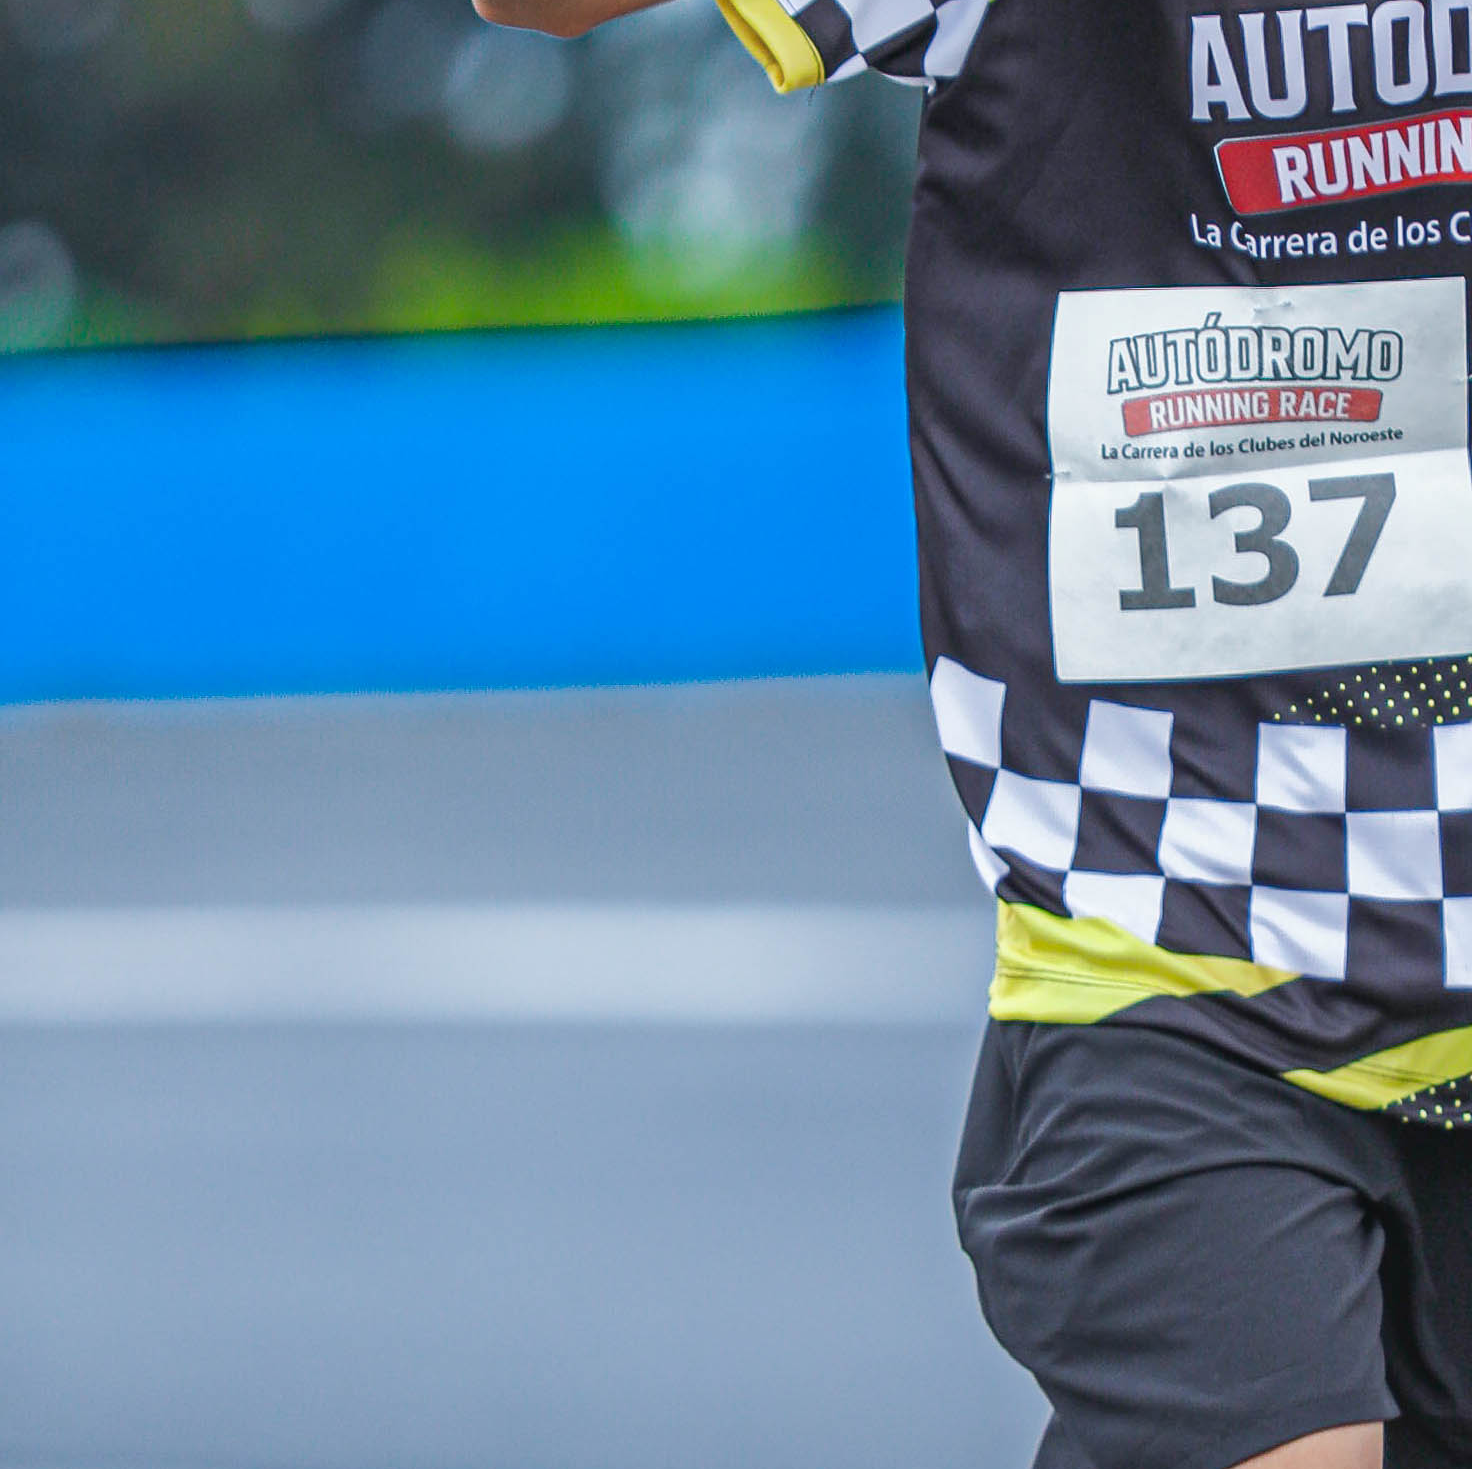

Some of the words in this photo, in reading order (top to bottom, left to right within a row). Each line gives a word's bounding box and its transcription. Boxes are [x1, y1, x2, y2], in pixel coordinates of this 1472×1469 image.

[1191, 212, 1222, 248] La
[1230, 220, 1338, 259] Carrera
[1348, 220, 1387, 254] de
[1396, 215, 1441, 248] los
[1106, 311, 1404, 395] AUTÓDROMO
[1149, 390, 1270, 430] RUNNING
[1279, 390, 1352, 420] RACE
[1101, 443, 1119, 460] La
[1122, 442, 1179, 460] Carrera
[1183, 441, 1206, 458] de
[1209, 440, 1234, 457] los
[1238, 436, 1296, 453] Clubes
[1299, 432, 1325, 449] del
[1329, 427, 1404, 445] Noroeste
[1114, 471, 1398, 611] 137
